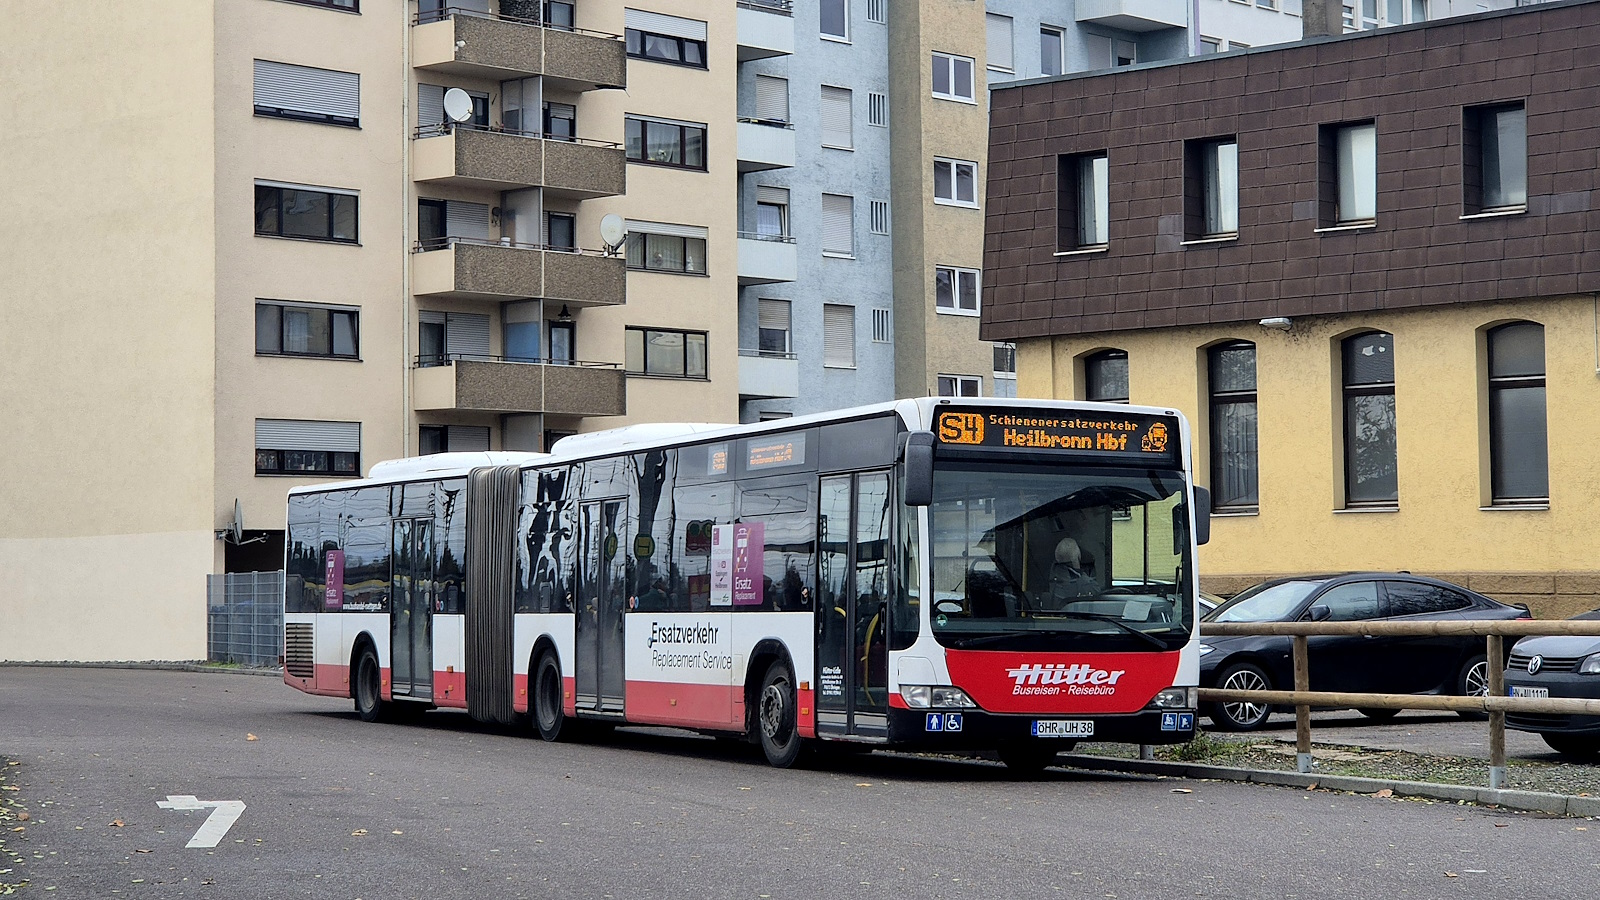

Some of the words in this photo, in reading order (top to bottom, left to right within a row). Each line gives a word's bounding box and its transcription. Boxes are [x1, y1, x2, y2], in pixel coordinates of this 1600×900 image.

[942, 413, 980, 442] S4
[989, 414, 1139, 432] Schienenersatzverkehr
[1003, 428, 1092, 450] Heilbronn
[1096, 432, 1128, 451] Hbf
[735, 577, 752, 590] Ersatz
[735, 591, 756, 601] Replacement
[651, 622, 719, 645] Ersatzverkehr
[652, 650, 700, 671] Replacement
[703, 651, 732, 670] Service
[1005, 664, 1126, 685] Hütter
[1012, 685, 1061, 695] Busreisen
[1068, 685, 1115, 695] Reisebüro
[1038, 722, 1058, 733] ÖHR
[1064, 722, 1079, 733] UH
[1080, 722, 1093, 733] 38
